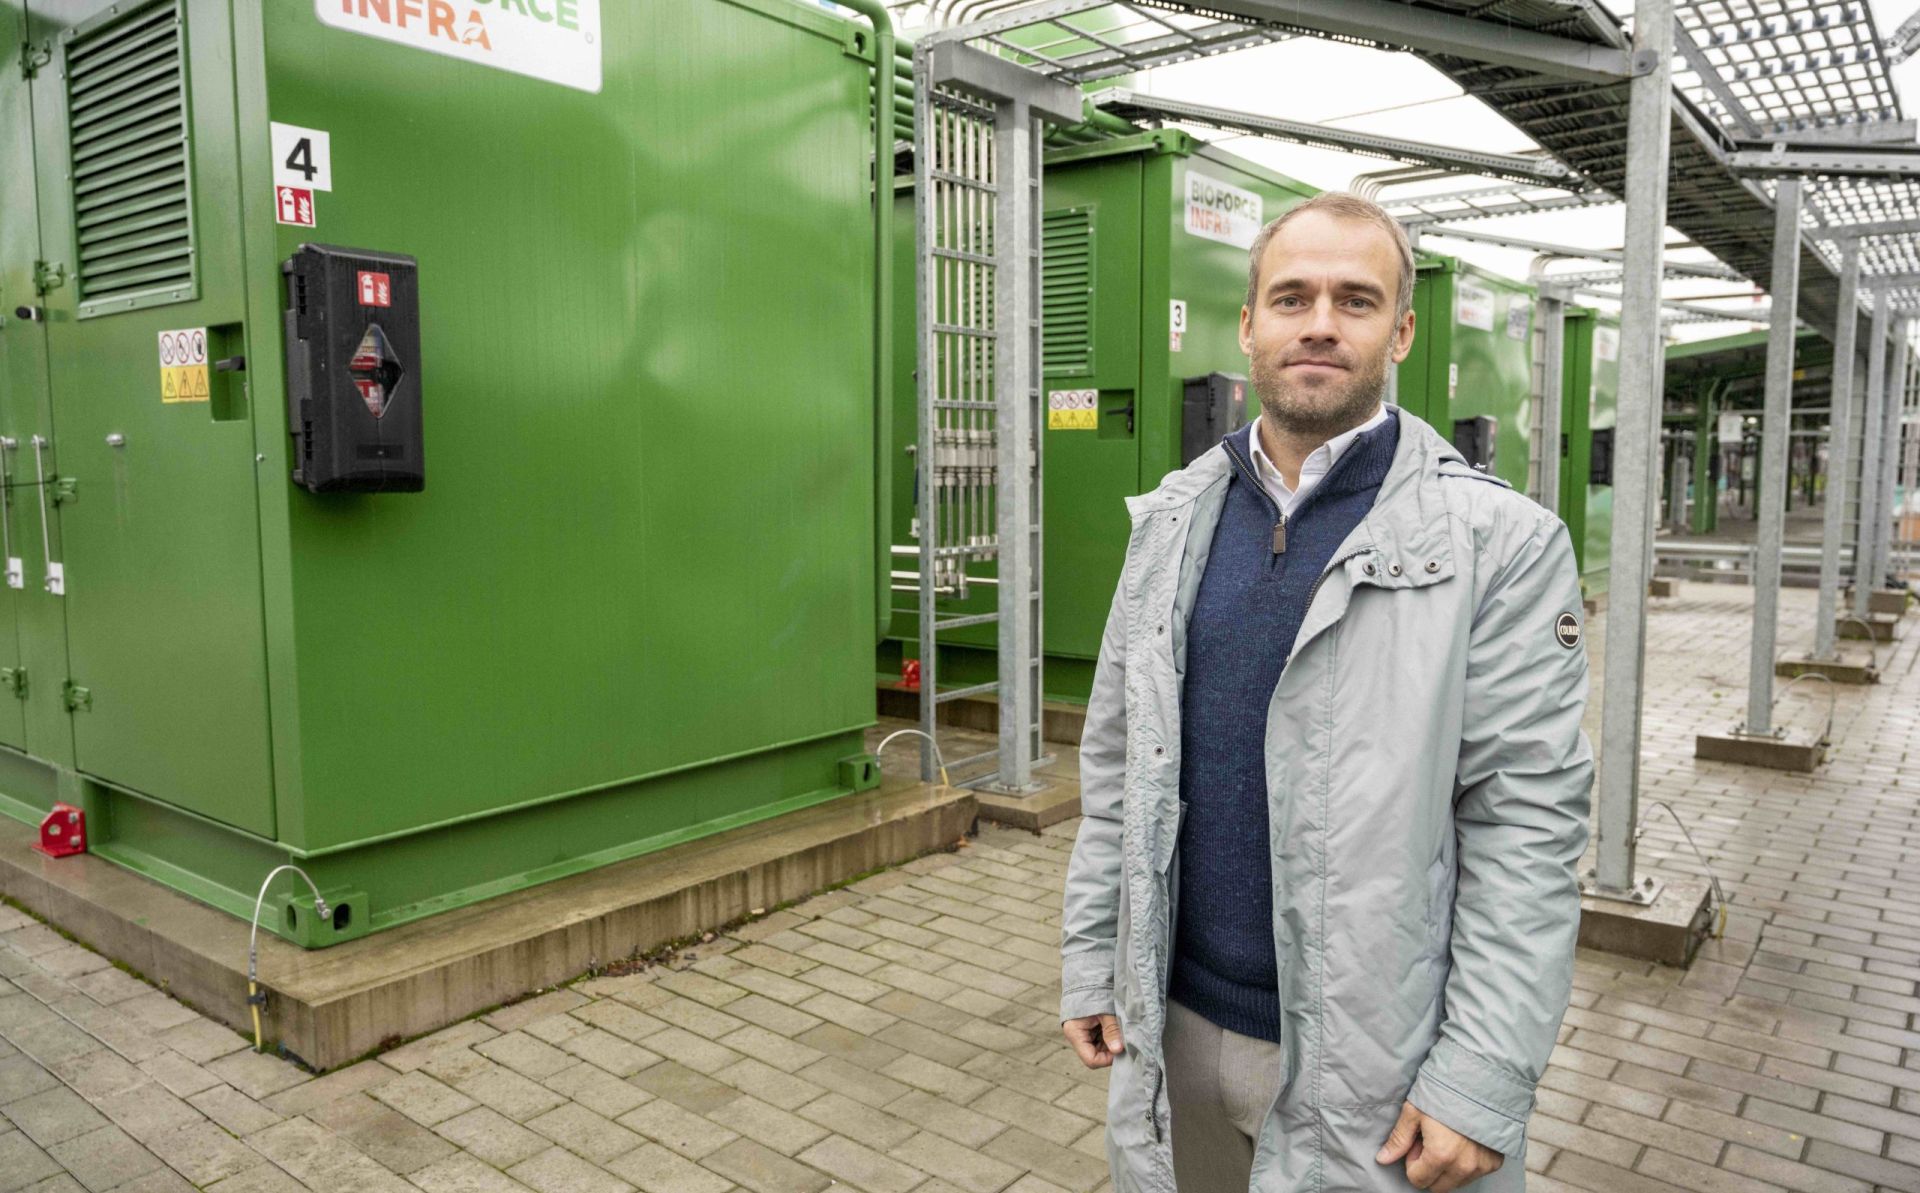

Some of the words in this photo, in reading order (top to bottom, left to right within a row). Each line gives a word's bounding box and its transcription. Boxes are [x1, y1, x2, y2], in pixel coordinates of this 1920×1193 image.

[286, 137, 318, 181] 4
[1191, 180, 1257, 221] BIOFORCE
[1190, 205, 1232, 237] INFRA
[1174, 304, 1182, 327] 3
